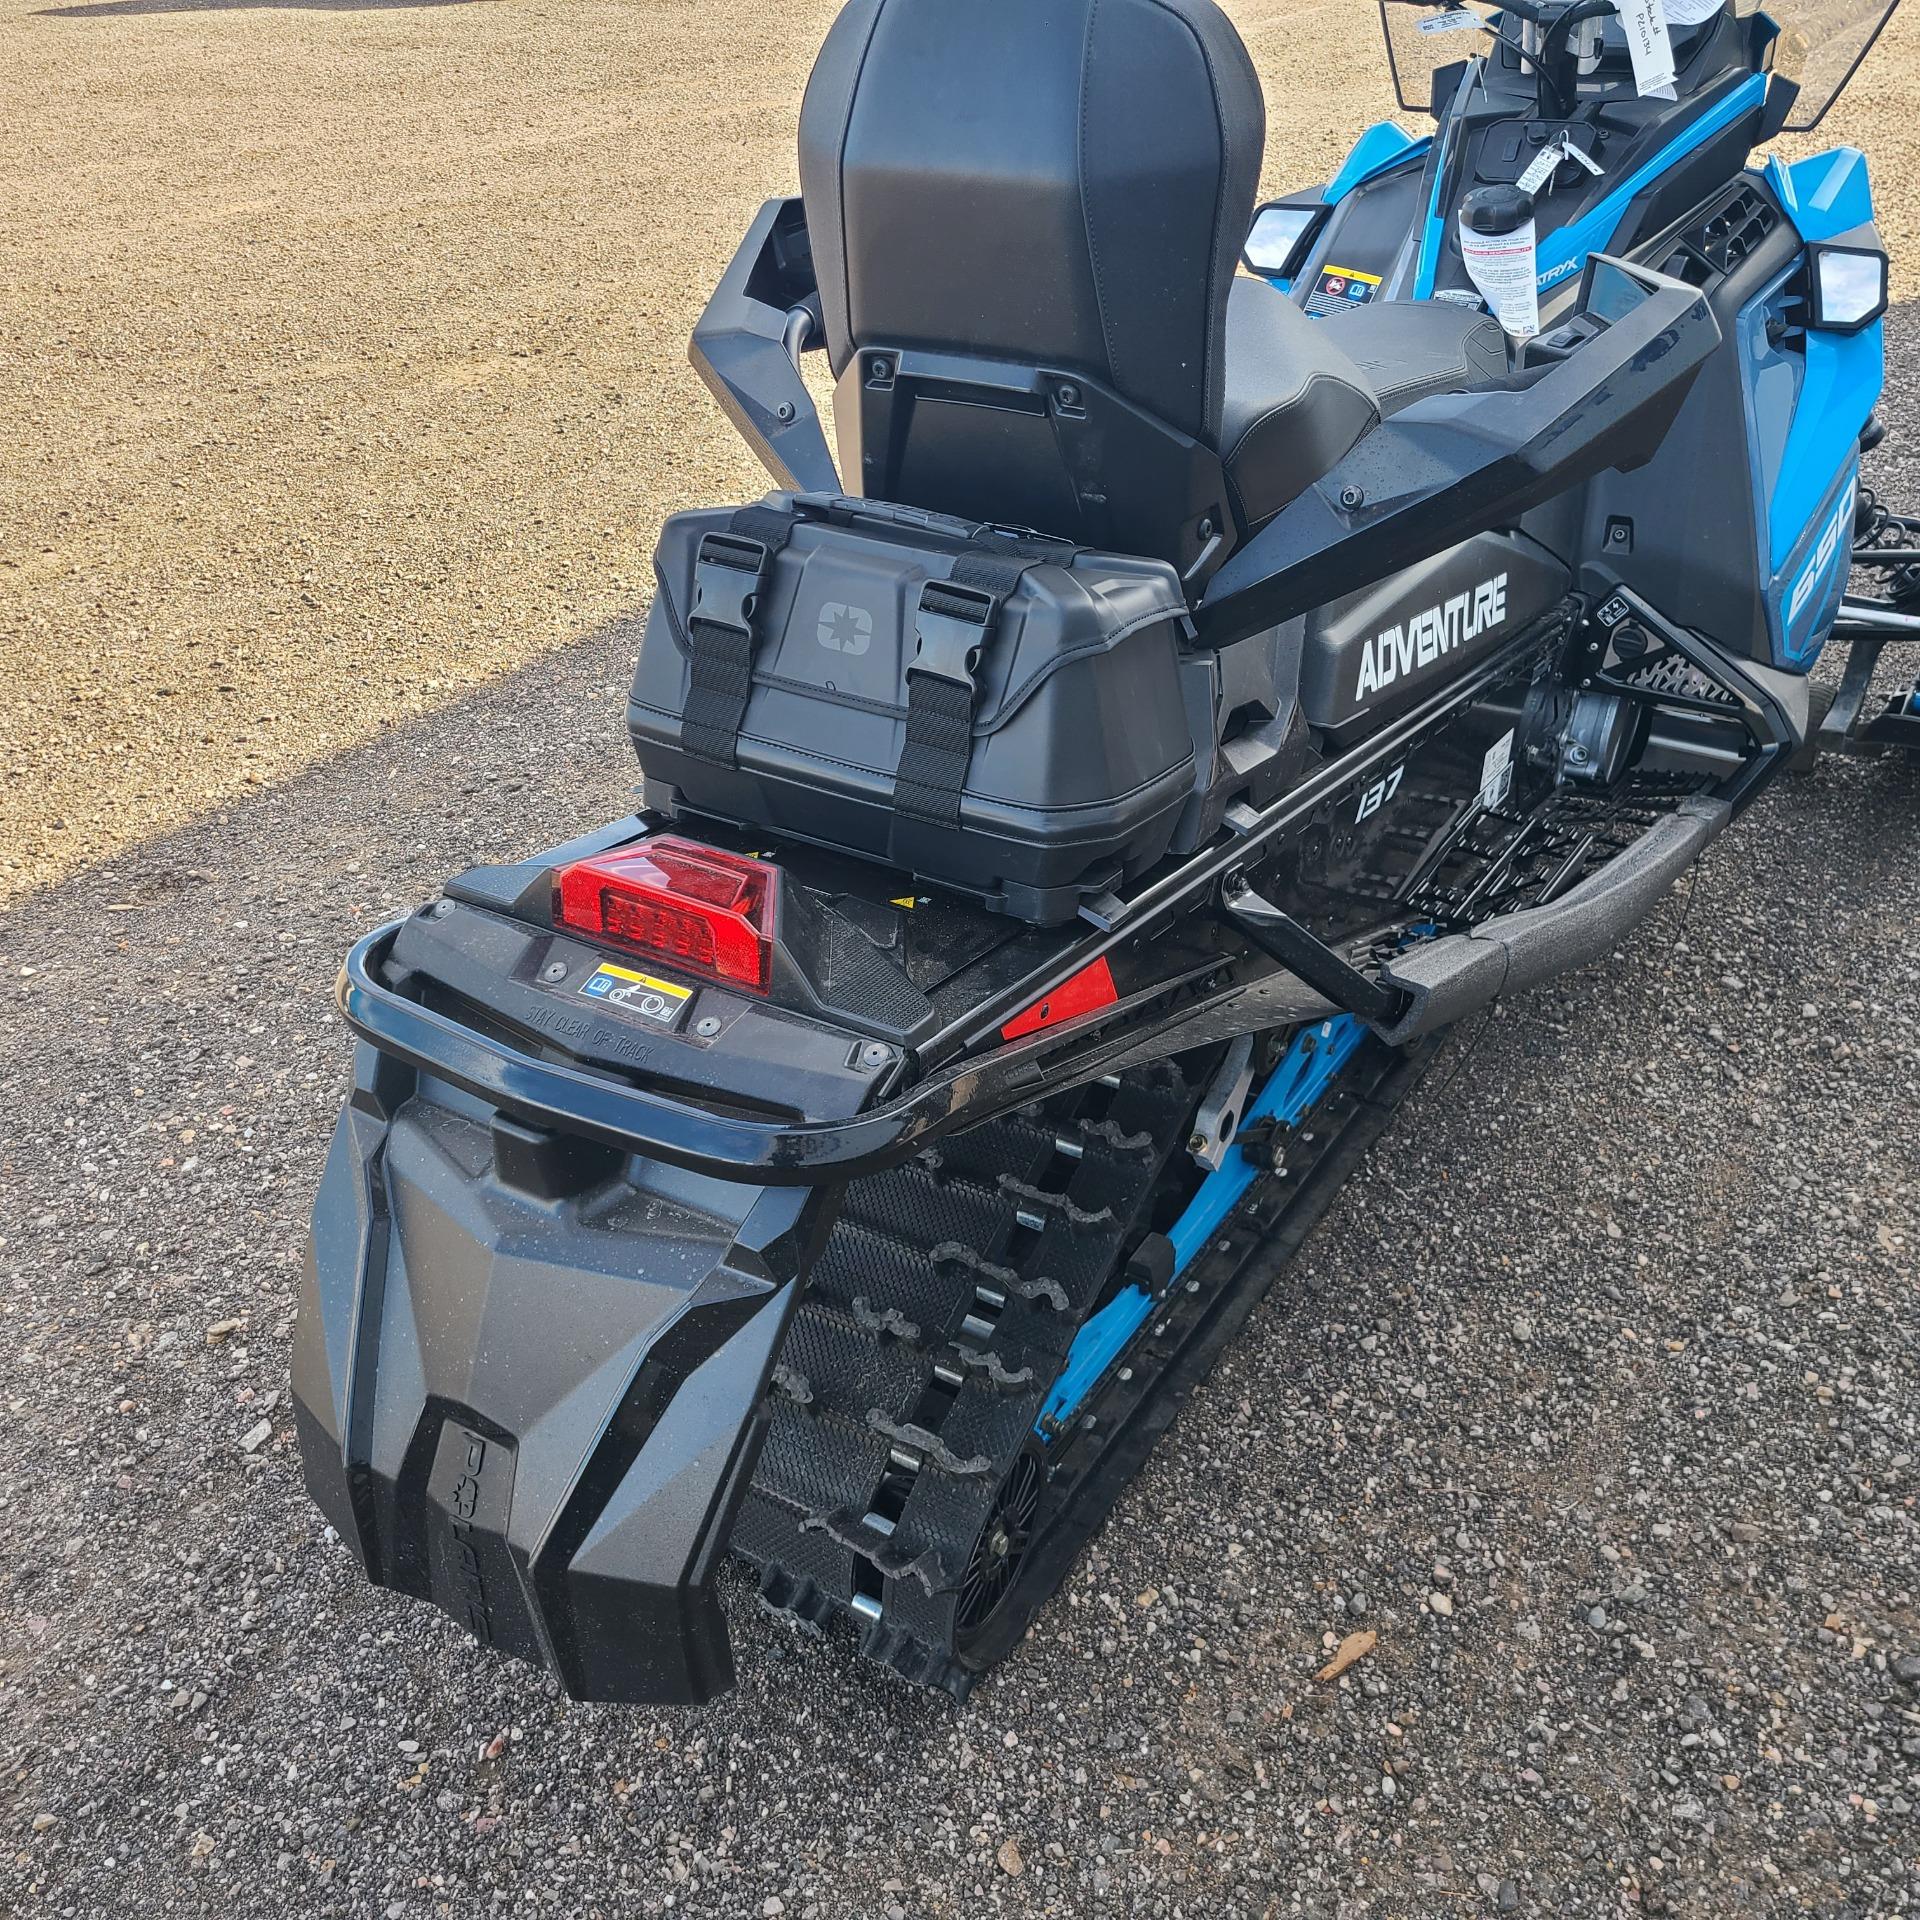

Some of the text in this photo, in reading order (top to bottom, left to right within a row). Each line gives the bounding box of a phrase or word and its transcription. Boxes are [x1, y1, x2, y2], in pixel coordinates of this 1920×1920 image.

[1635, 12, 1652, 56] P210134
[1787, 475, 1856, 626] 650
[1355, 571, 1507, 701] ADVENTURE
[1354, 764, 1405, 824] 137
[524, 1006, 656, 1064] STAY CLEAR OF TRACK
